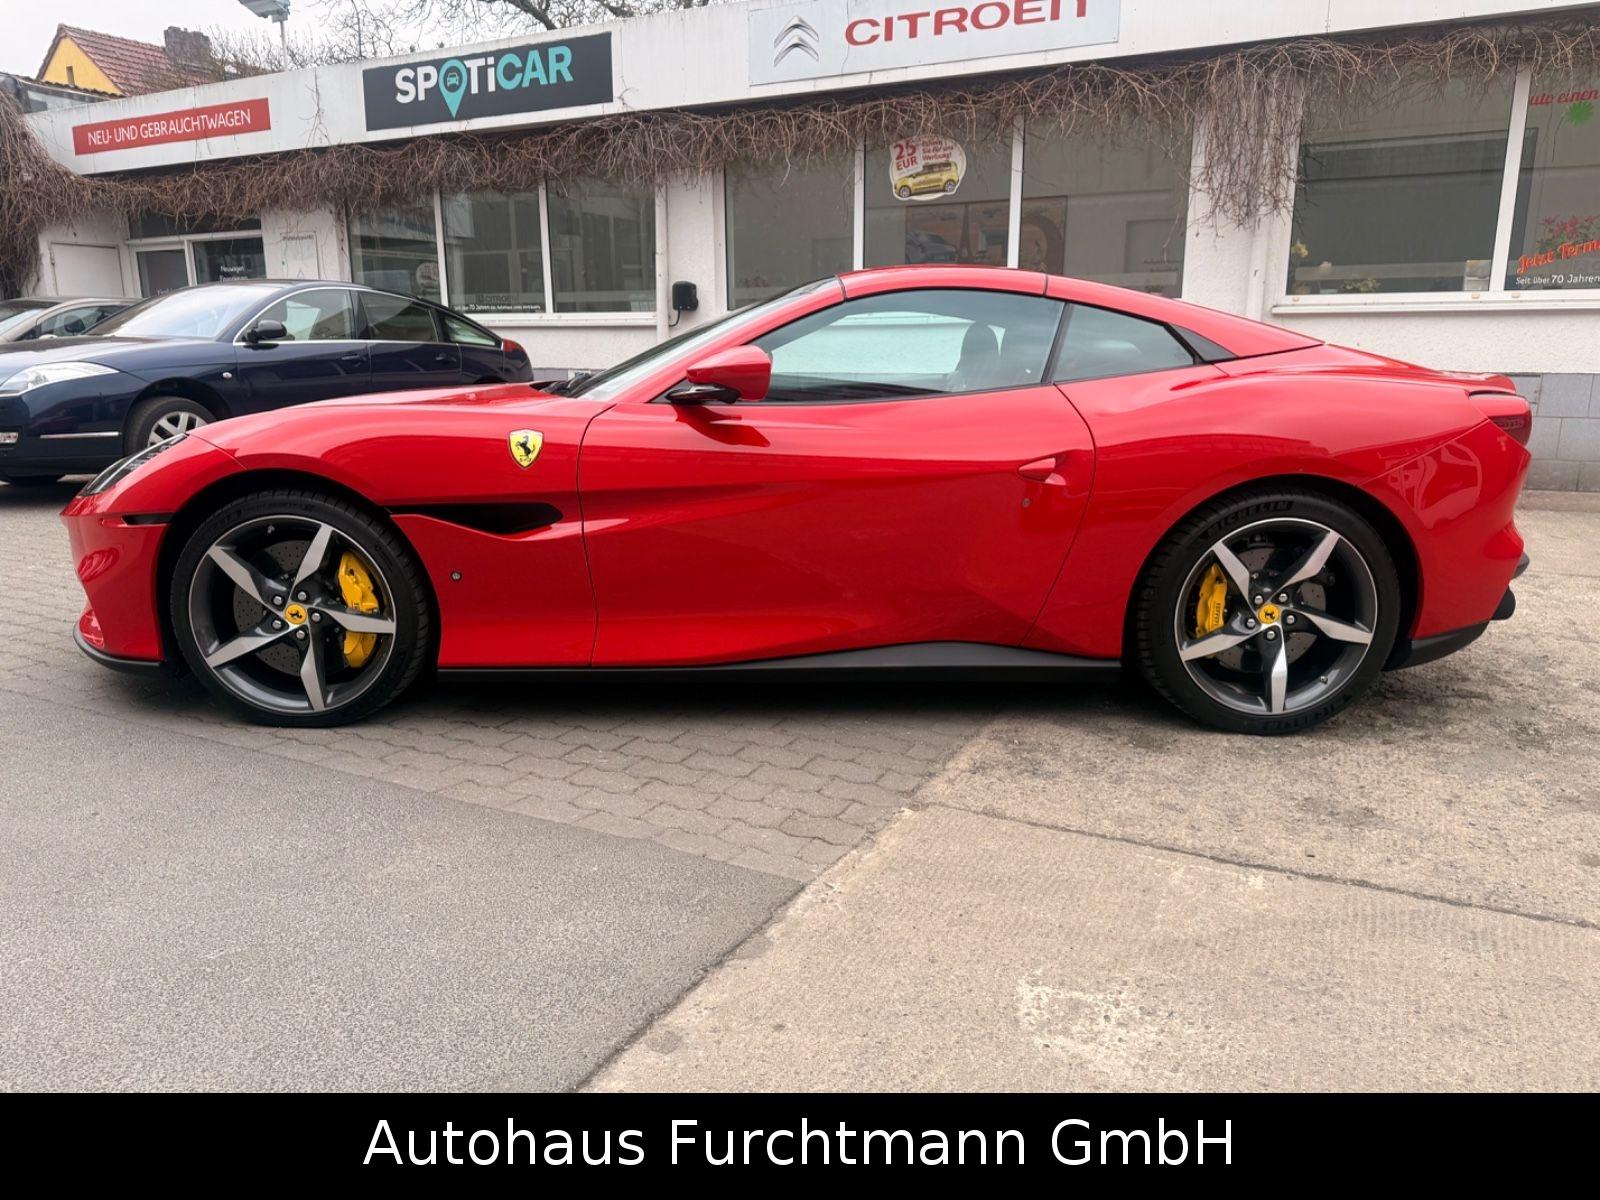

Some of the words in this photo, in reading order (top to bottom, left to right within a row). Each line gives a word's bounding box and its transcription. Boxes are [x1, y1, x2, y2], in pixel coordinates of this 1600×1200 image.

[87, 130, 112, 147] NEU-
[114, 125, 139, 143] UND
[140, 108, 252, 139] GEBRAUCHTWAGEN
[893, 138, 917, 160] 25
[895, 156, 918, 171] EUR
[1516, 248, 1556, 276] Jetzt
[1515, 277, 1531, 285] Seit
[1533, 276, 1550, 285] über
[1551, 274, 1564, 284] 70
[1567, 273, 1600, 284] Jahren
